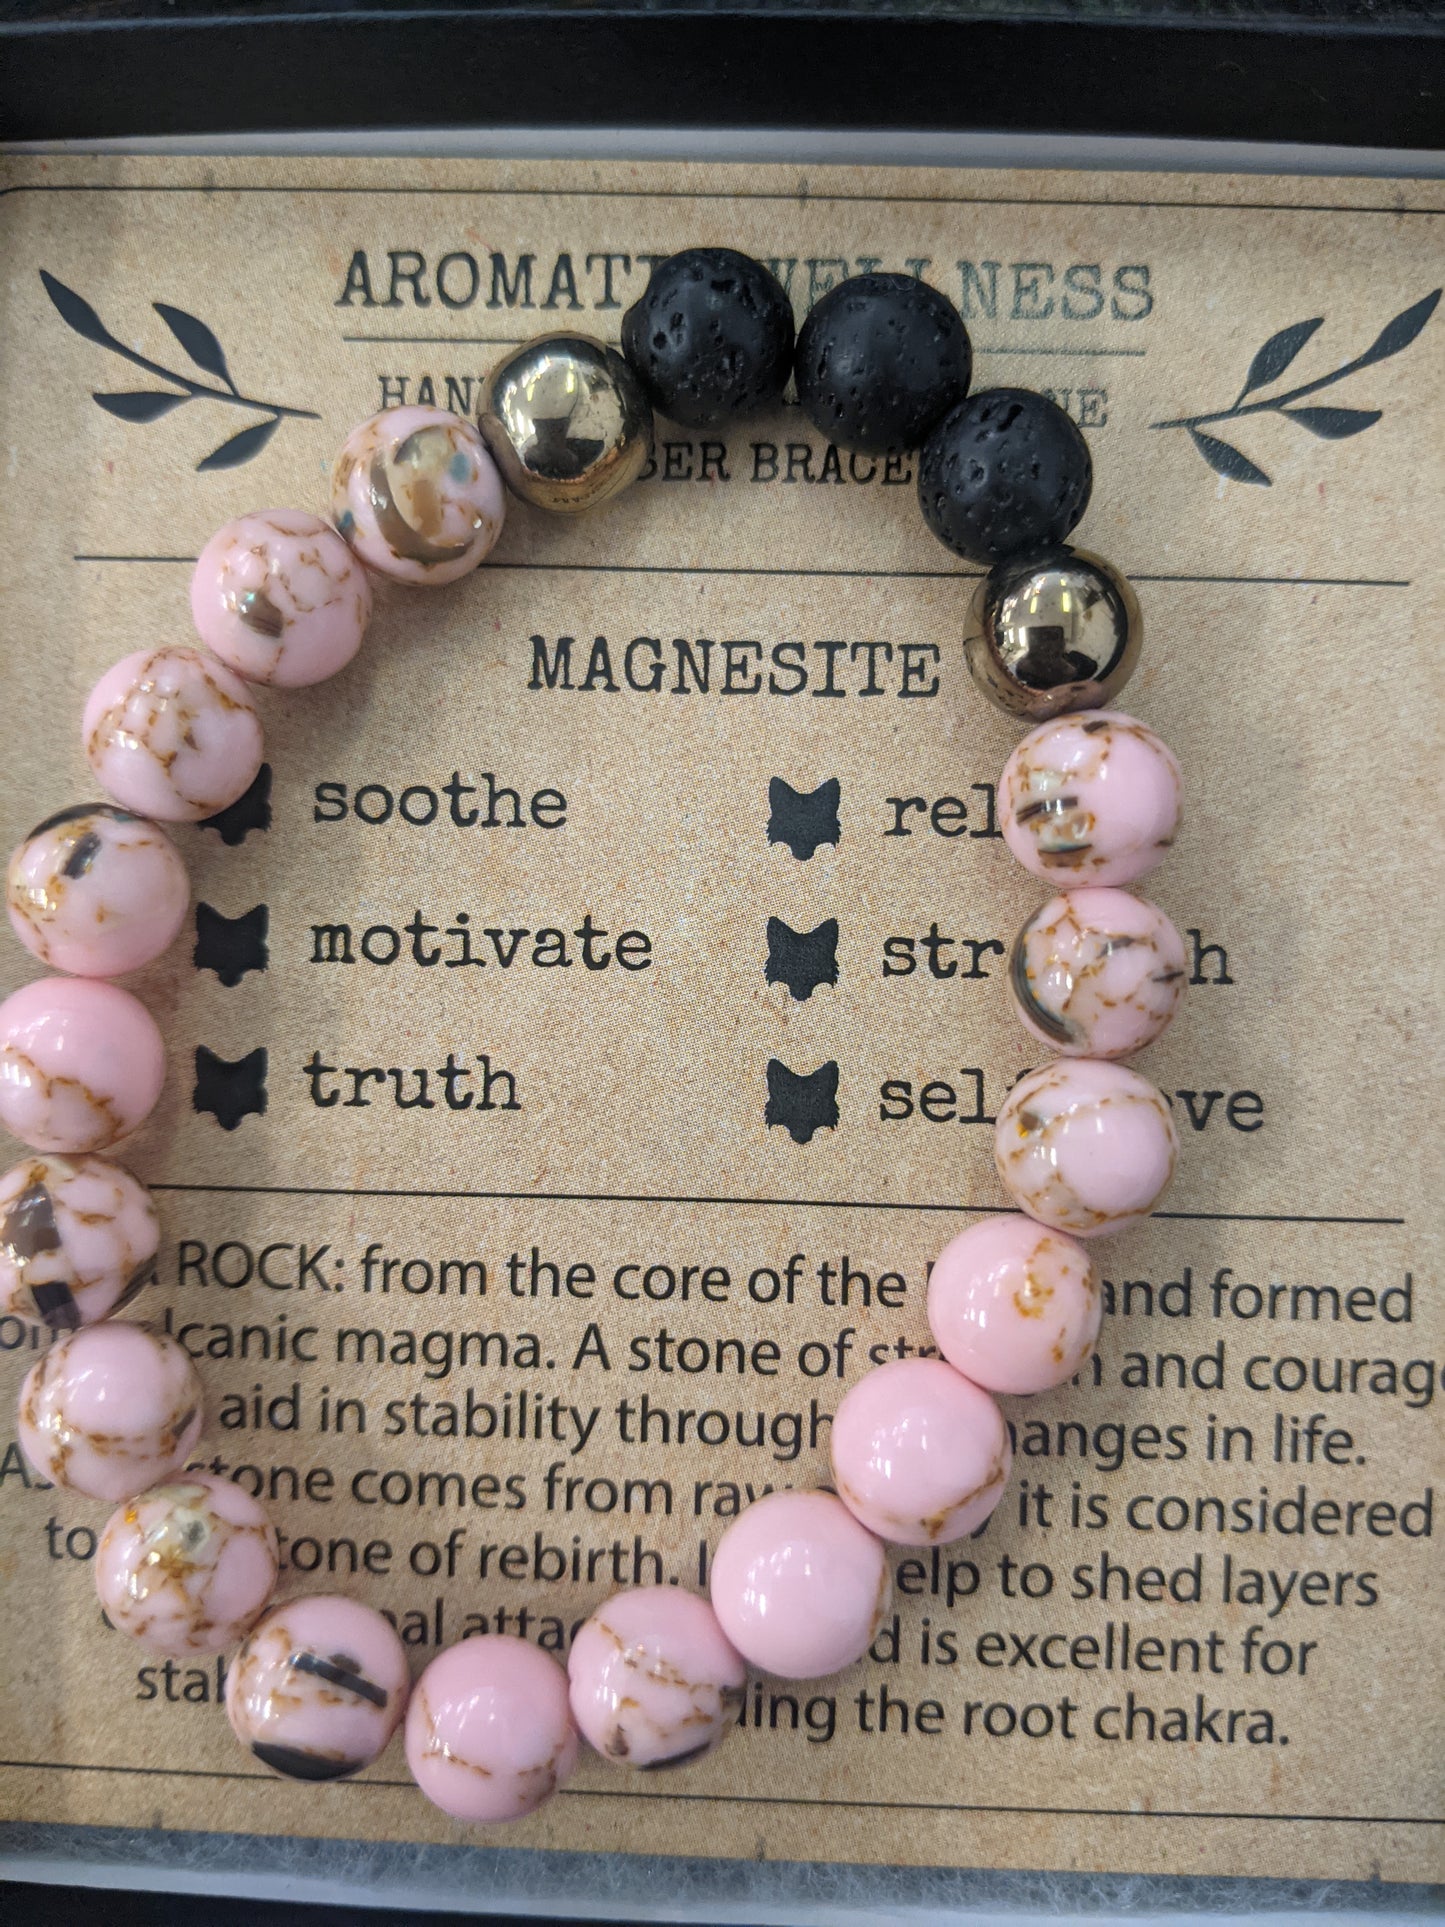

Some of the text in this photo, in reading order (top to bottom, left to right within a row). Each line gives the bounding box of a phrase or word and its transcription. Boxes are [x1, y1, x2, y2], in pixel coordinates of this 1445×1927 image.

[334, 250, 671, 310] AROMAT
[527, 634, 941, 699] MAGNESITE
[313, 772, 1003, 839] soothe rel
[309, 911, 653, 971] motivate
[302, 1050, 522, 1111] truth
[178, 1240, 345, 1292] ROCK:
[361, 1243, 487, 1295] from
[505, 1247, 596, 1298] the
[613, 1262, 730, 1301] core
[748, 1254, 805, 1304] of
[817, 1256, 907, 1308] the
[1209, 1267, 1412, 1322] formed
[337, 1326, 556, 1379] magma.
[573, 1322, 612, 1371] A
[628, 1329, 781, 1376] stone
[799, 1328, 855, 1378] of
[1121, 1340, 1225, 1390] and
[1243, 1340, 1445, 1408] courag
[220, 1382, 300, 1431] aid
[320, 1385, 366, 1433] in
[385, 1388, 600, 1455] stability
[616, 1394, 832, 1460] through
[1206, 1413, 1253, 1461] in
[1274, 1413, 1366, 1465] life.
[351, 1469, 526, 1510] comes
[543, 1461, 673, 1513] from
[1018, 1480, 1054, 1528] it
[1071, 1480, 1109, 1529] is
[1127, 1484, 1434, 1538] considered
[45, 1516, 97, 1560] to
[410, 1529, 467, 1577] of
[479, 1531, 679, 1586] rebirth.
[896, 1546, 980, 1607] elp
[998, 1553, 1054, 1599] to
[1071, 1550, 1201, 1602] shed
[1223, 1554, 1379, 1617] layers
[921, 1617, 958, 1665] is
[975, 1621, 1226, 1675] excellent
[1242, 1624, 1318, 1676] for
[854, 1683, 945, 1734] the
[963, 1696, 1078, 1739] root
[1093, 1690, 1289, 1746] chakra.
